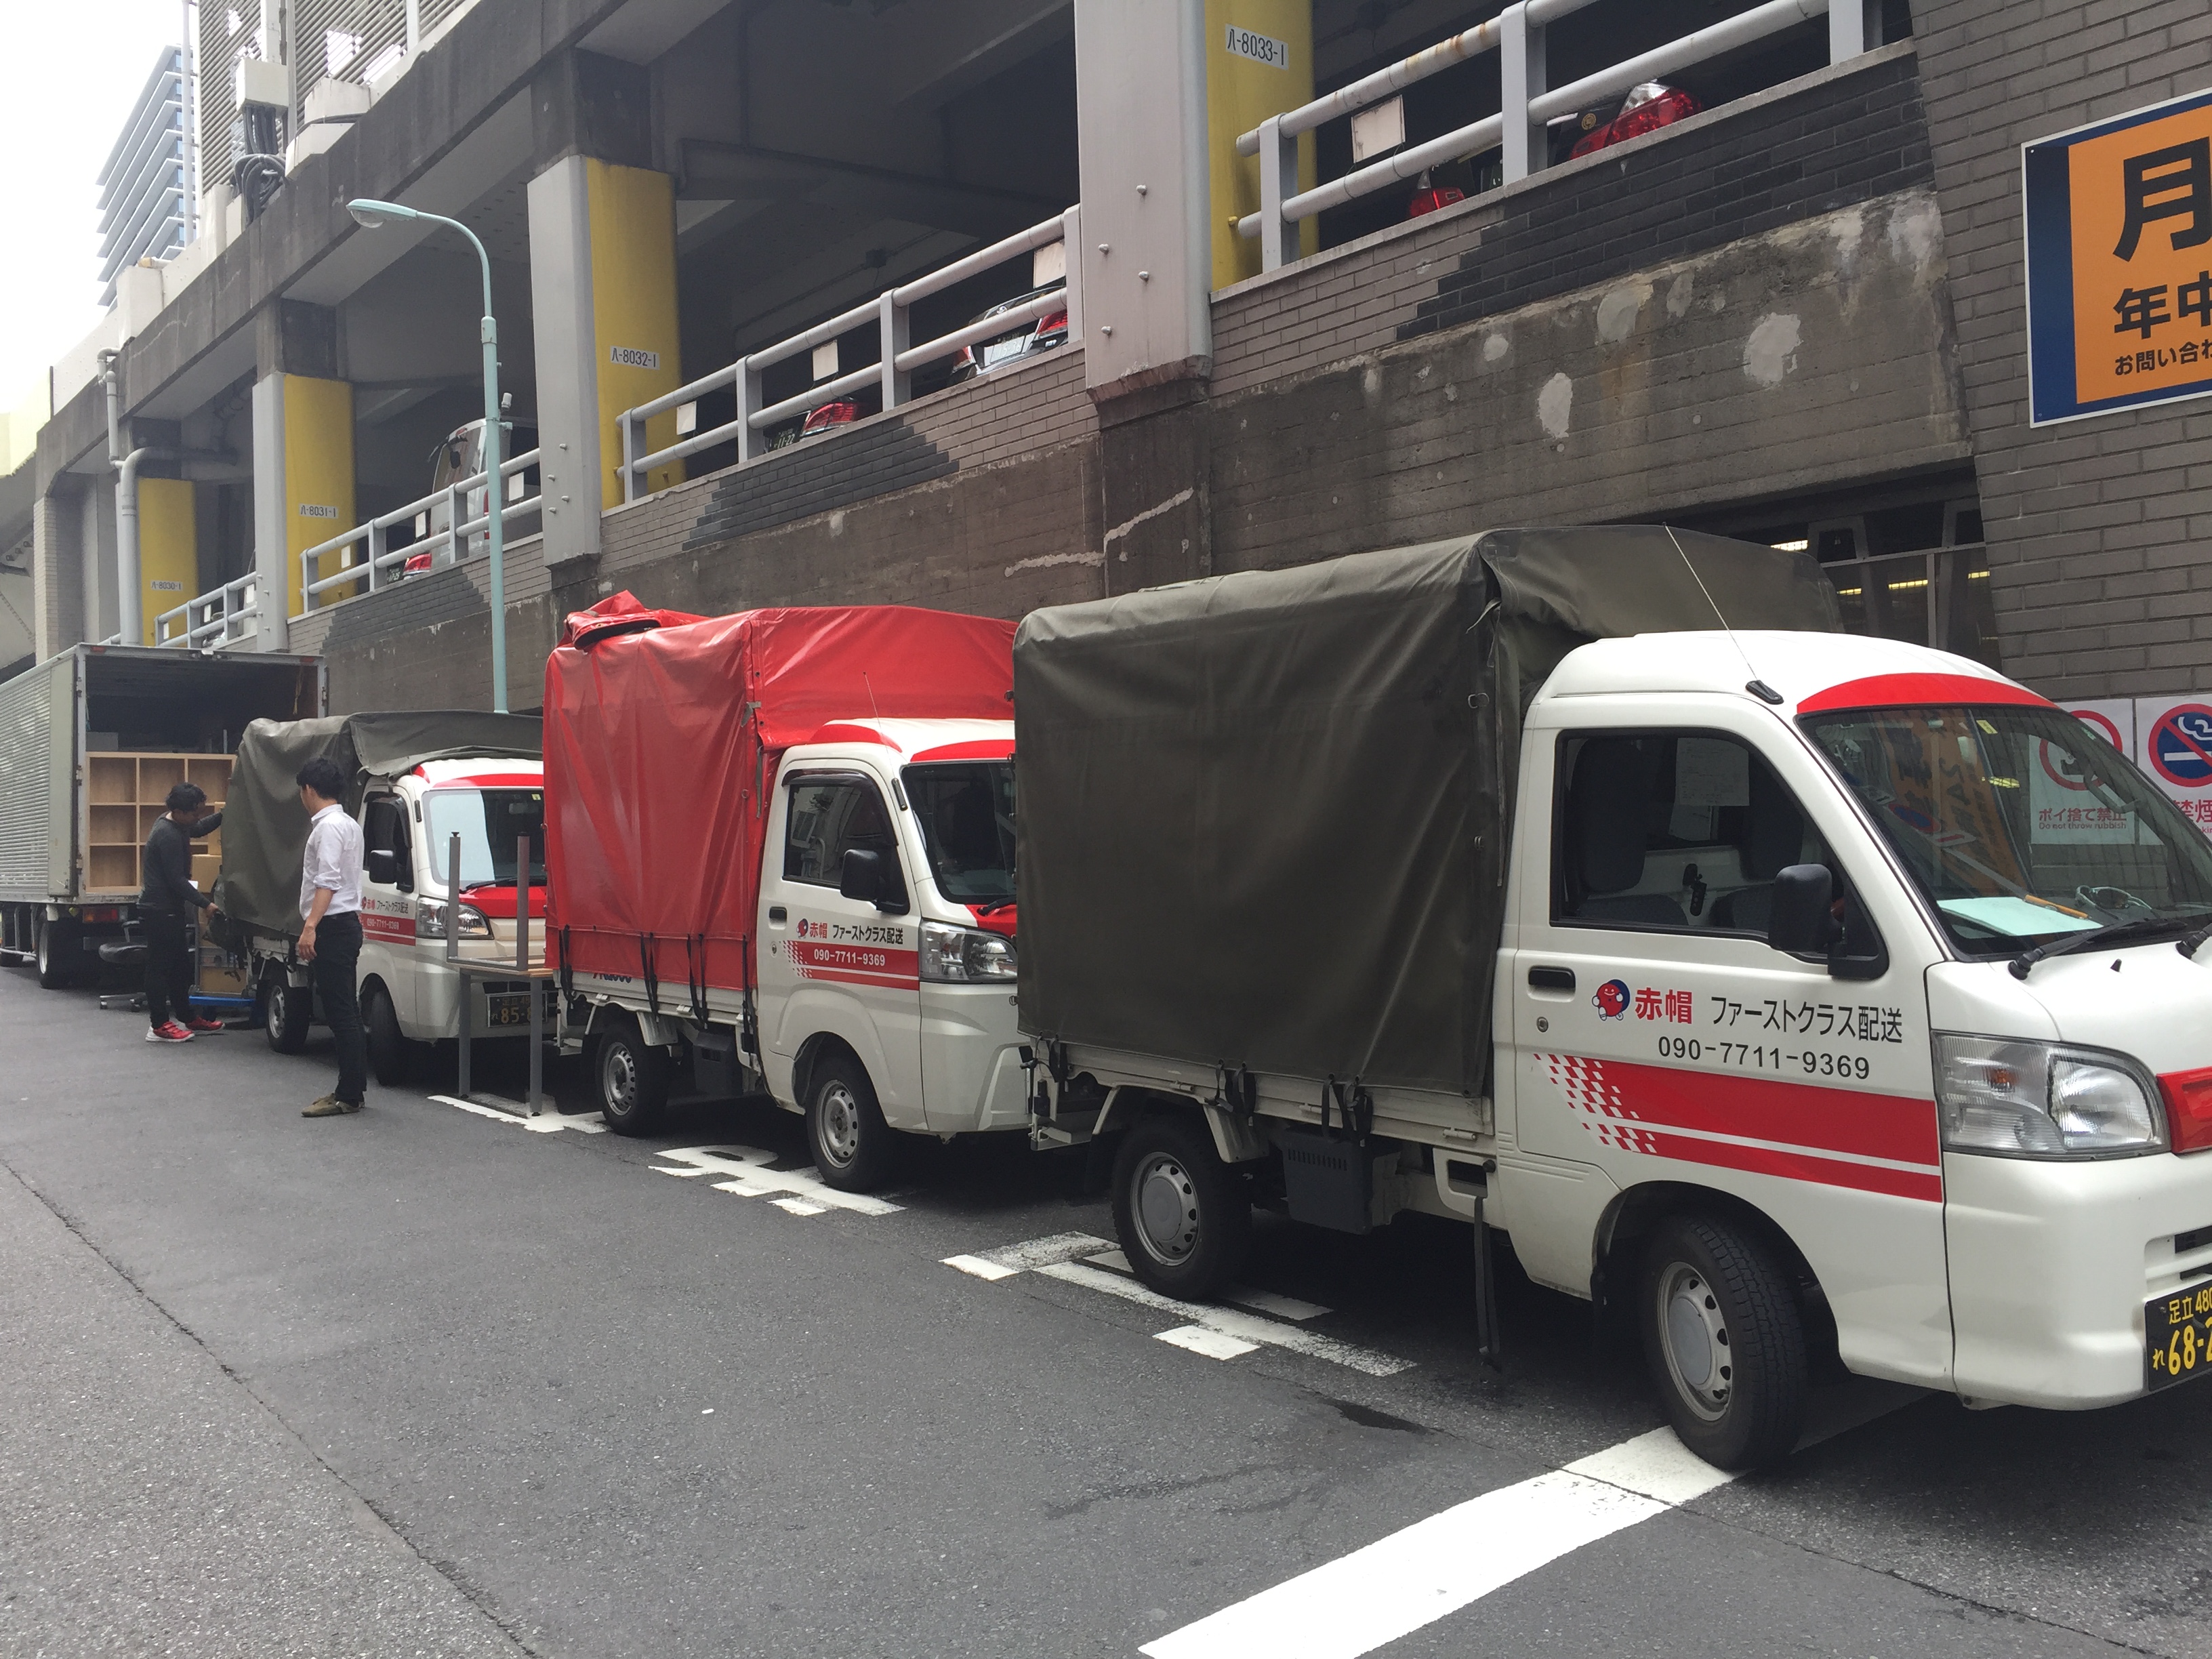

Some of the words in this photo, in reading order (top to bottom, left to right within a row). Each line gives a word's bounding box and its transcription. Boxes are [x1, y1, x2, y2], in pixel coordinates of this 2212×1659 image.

[2112, 136, 2212, 262] 月
[2113, 270, 2212, 340] 年中
[2039, 807, 2127, 821] ポイ捨て禁止
[809, 922, 828, 939] 赤帽
[832, 924, 903, 945] ファーストクラス配送
[814, 948, 886, 966] 090-7711-9369
[1635, 987, 1693, 1025] 赤帽
[1711, 996, 1903, 1044] ファーストクラス配送
[1658, 1036, 1870, 1080] 090-7711-9369
[2169, 1296, 2194, 1325] 足立
